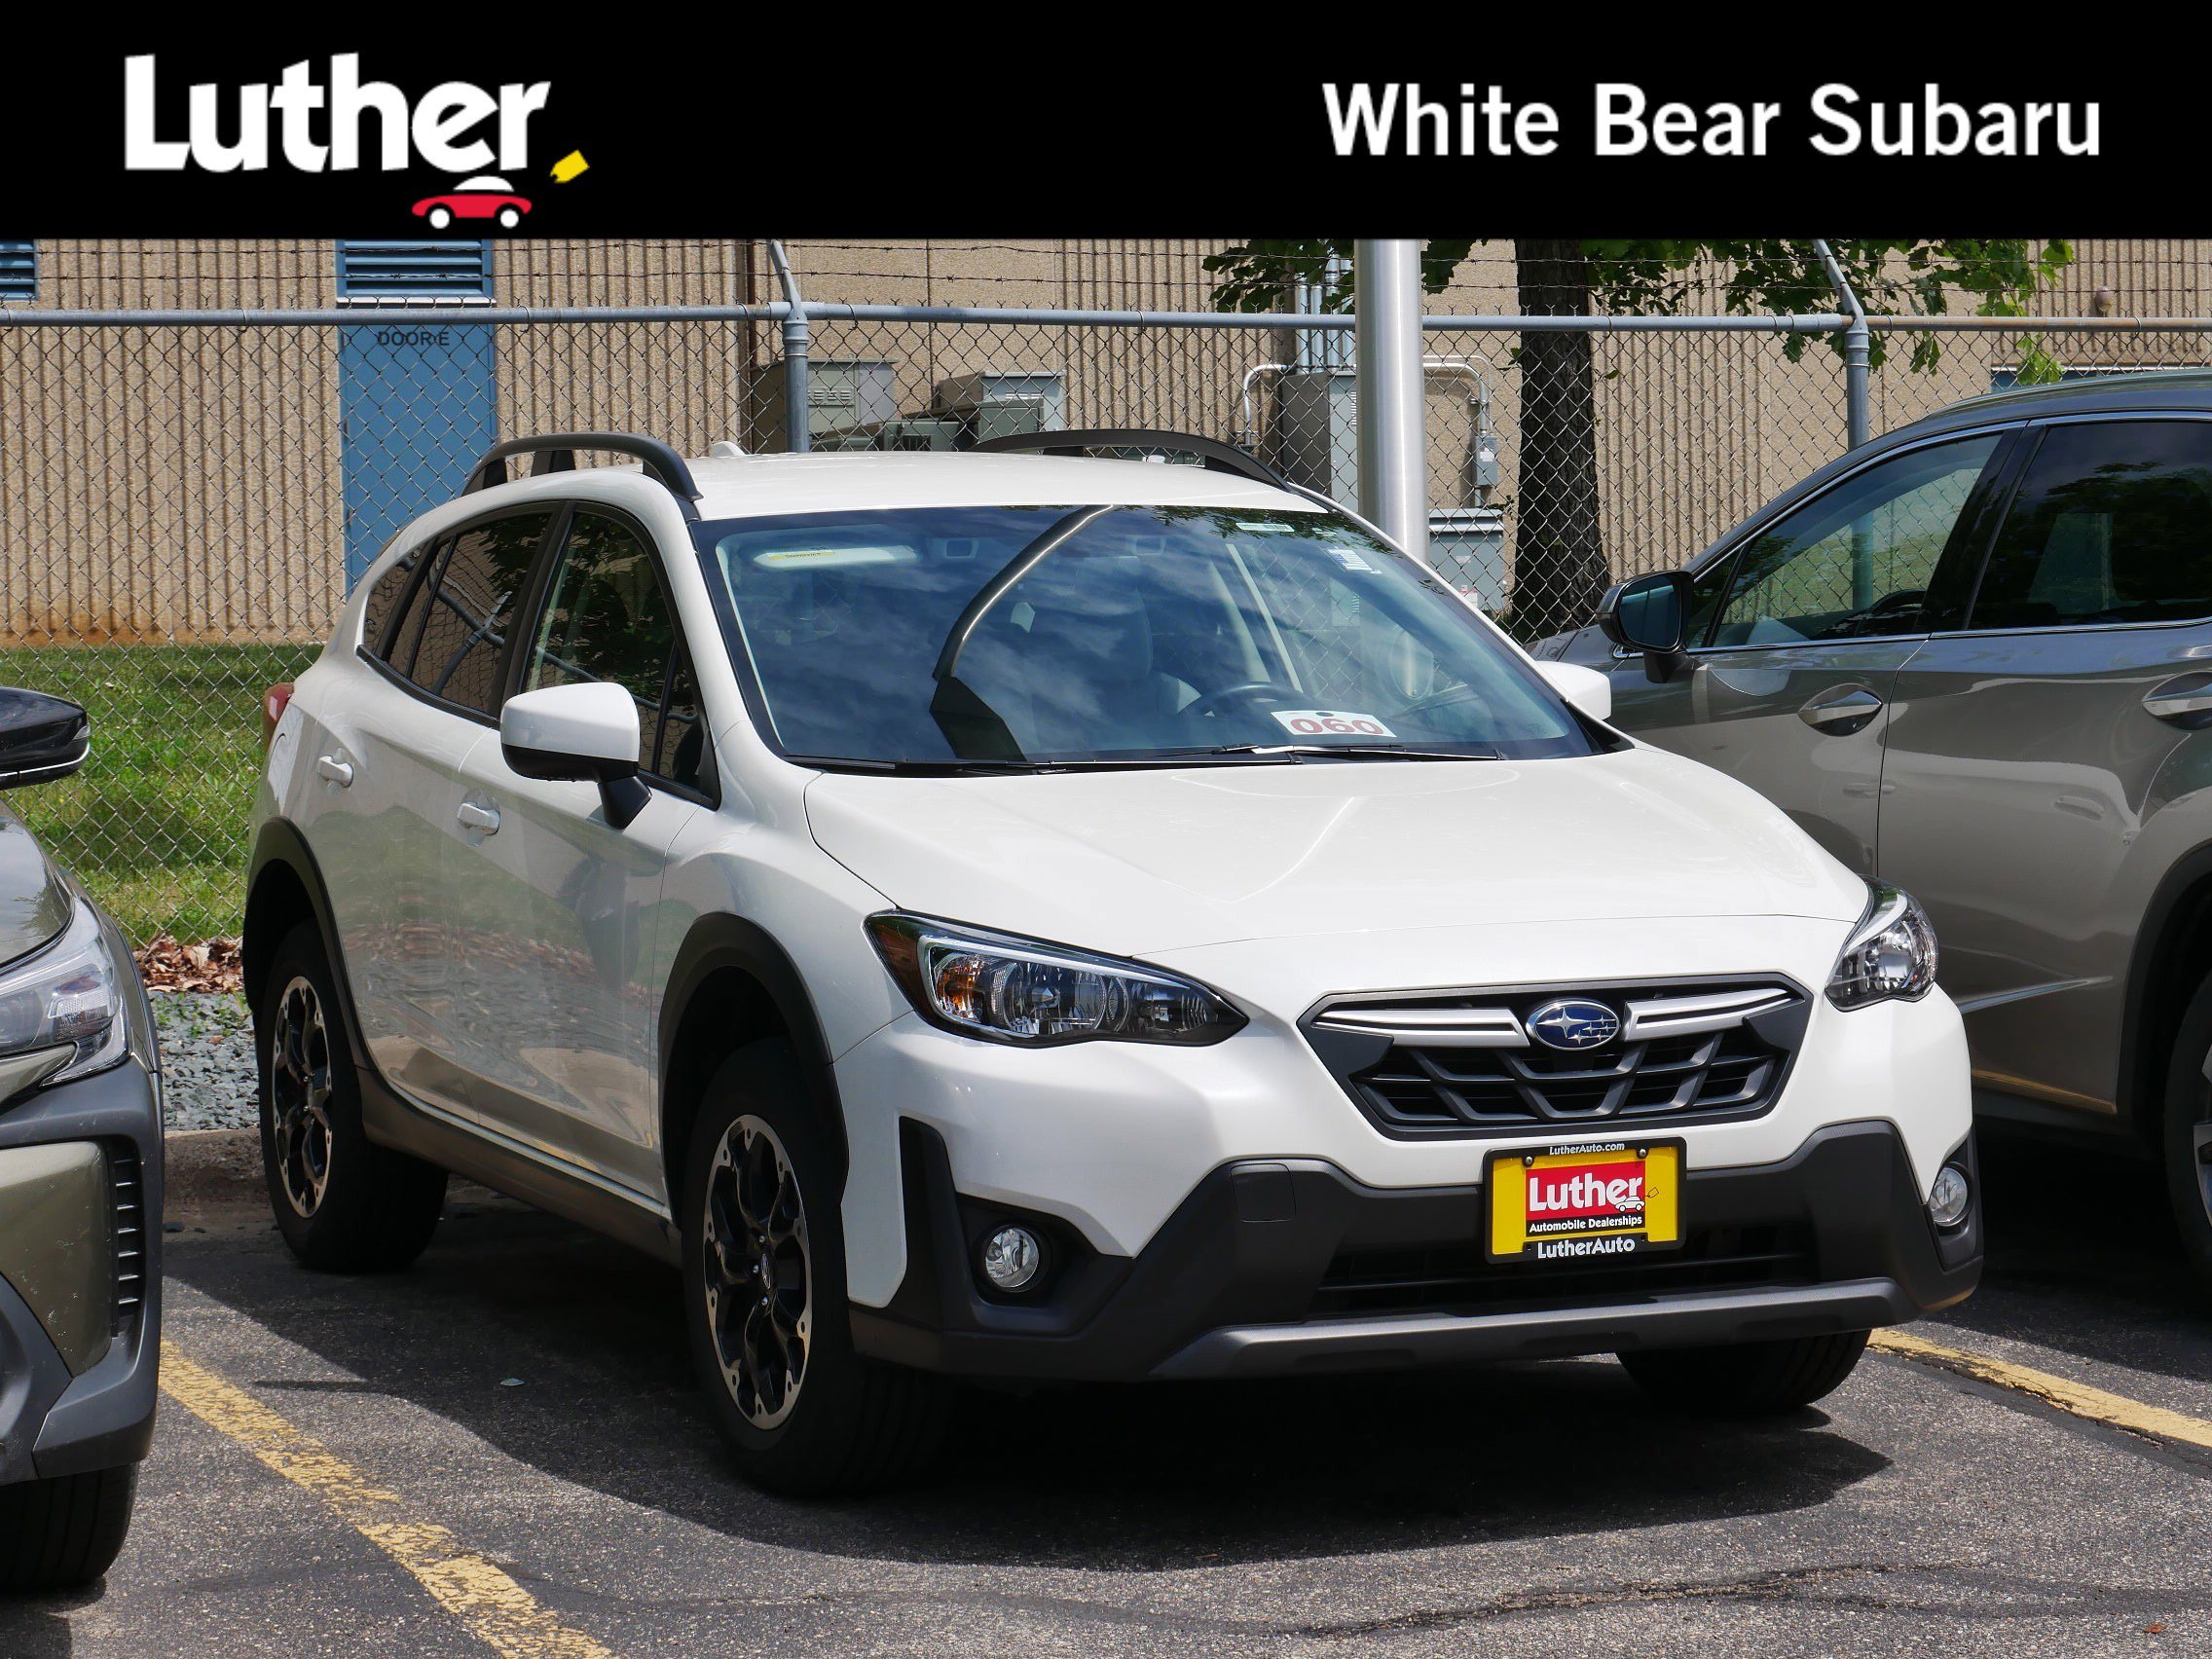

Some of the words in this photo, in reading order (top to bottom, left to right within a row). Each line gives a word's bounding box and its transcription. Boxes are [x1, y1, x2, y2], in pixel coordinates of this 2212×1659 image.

[1290, 718, 1384, 735] 060
[1549, 1142, 1625, 1155] LutherAuto.com
[1529, 1172, 1642, 1211] Luther
[1529, 1219, 1586, 1233] Automobile
[1588, 1216, 1642, 1229] Dealerships
[1537, 1235, 1636, 1258] LutherAuto
